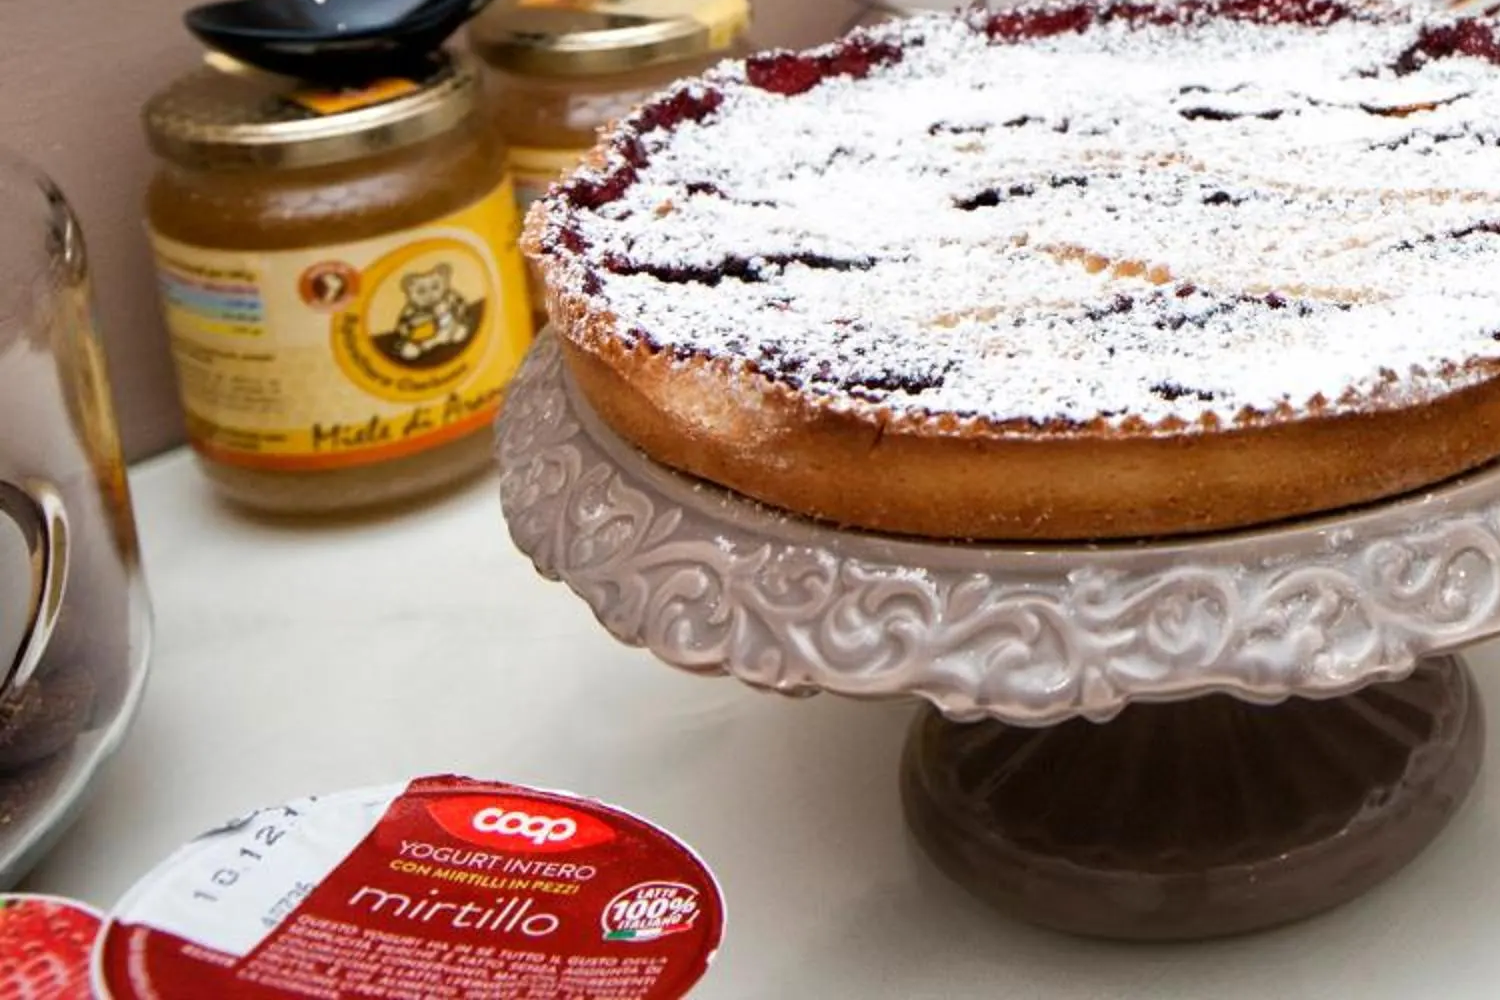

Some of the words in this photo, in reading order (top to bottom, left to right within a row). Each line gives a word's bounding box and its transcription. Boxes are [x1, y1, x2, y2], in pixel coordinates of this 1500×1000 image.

[312, 415, 391, 449] Miele
[402, 405, 433, 436] di
[472, 807, 577, 845] coop
[389, 859, 432, 875] CON
[432, 868, 505, 891] MIRTILLI
[508, 880, 532, 892] IN
[533, 880, 581, 896] PEZZI
[399, 840, 502, 870] YOGURT
[503, 855, 597, 881] INTERO
[347, 885, 560, 937] mirtillo
[612, 894, 697, 921] 100%
[636, 887, 679, 900] LATTE
[617, 911, 684, 930] ITALIANO
